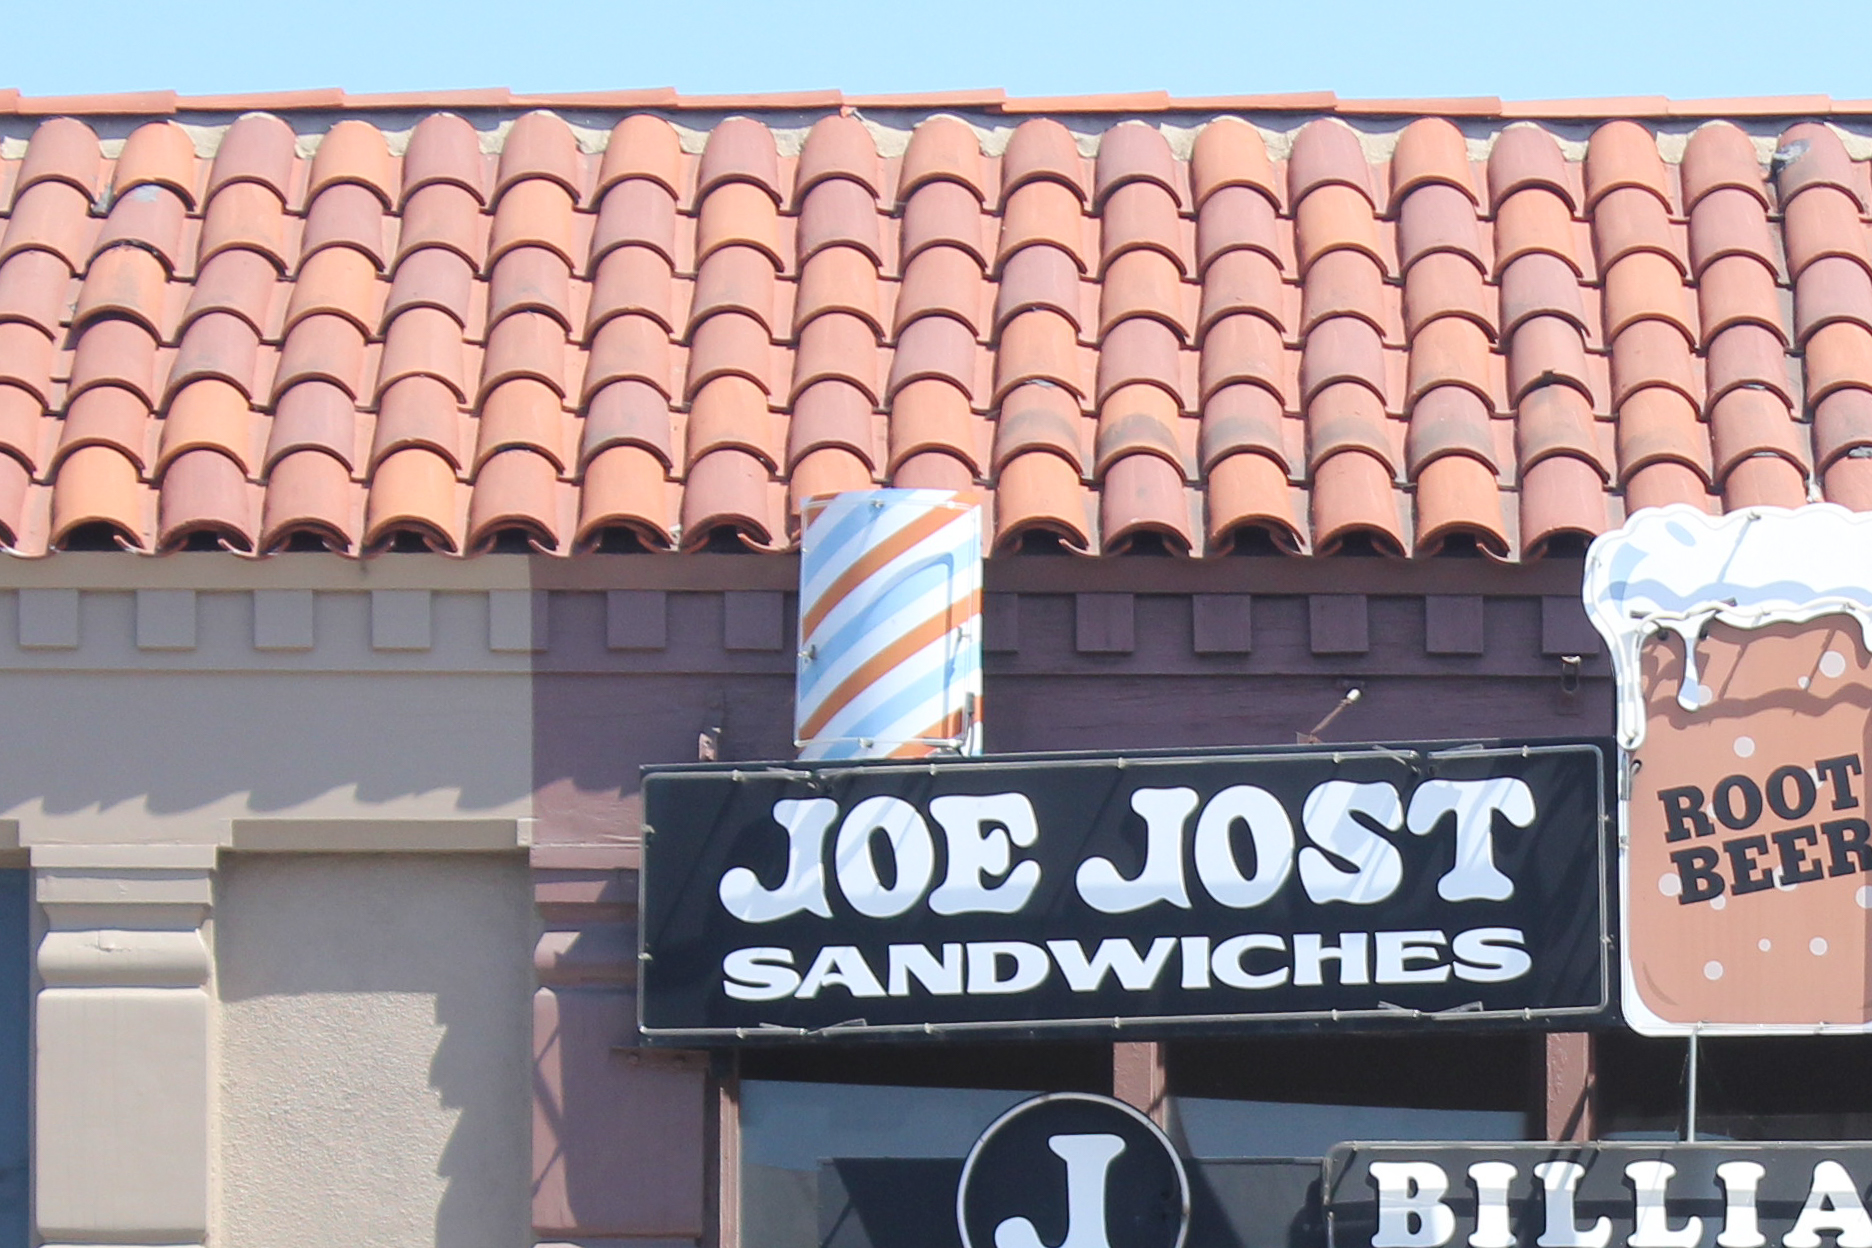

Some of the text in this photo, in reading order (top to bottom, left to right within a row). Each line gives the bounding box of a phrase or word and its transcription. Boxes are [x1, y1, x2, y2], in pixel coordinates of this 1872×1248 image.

[1657, 754, 1864, 844] ROOT
[718, 778, 1537, 923] JOE JOST
[722, 927, 1534, 1001] SANDWICHES
